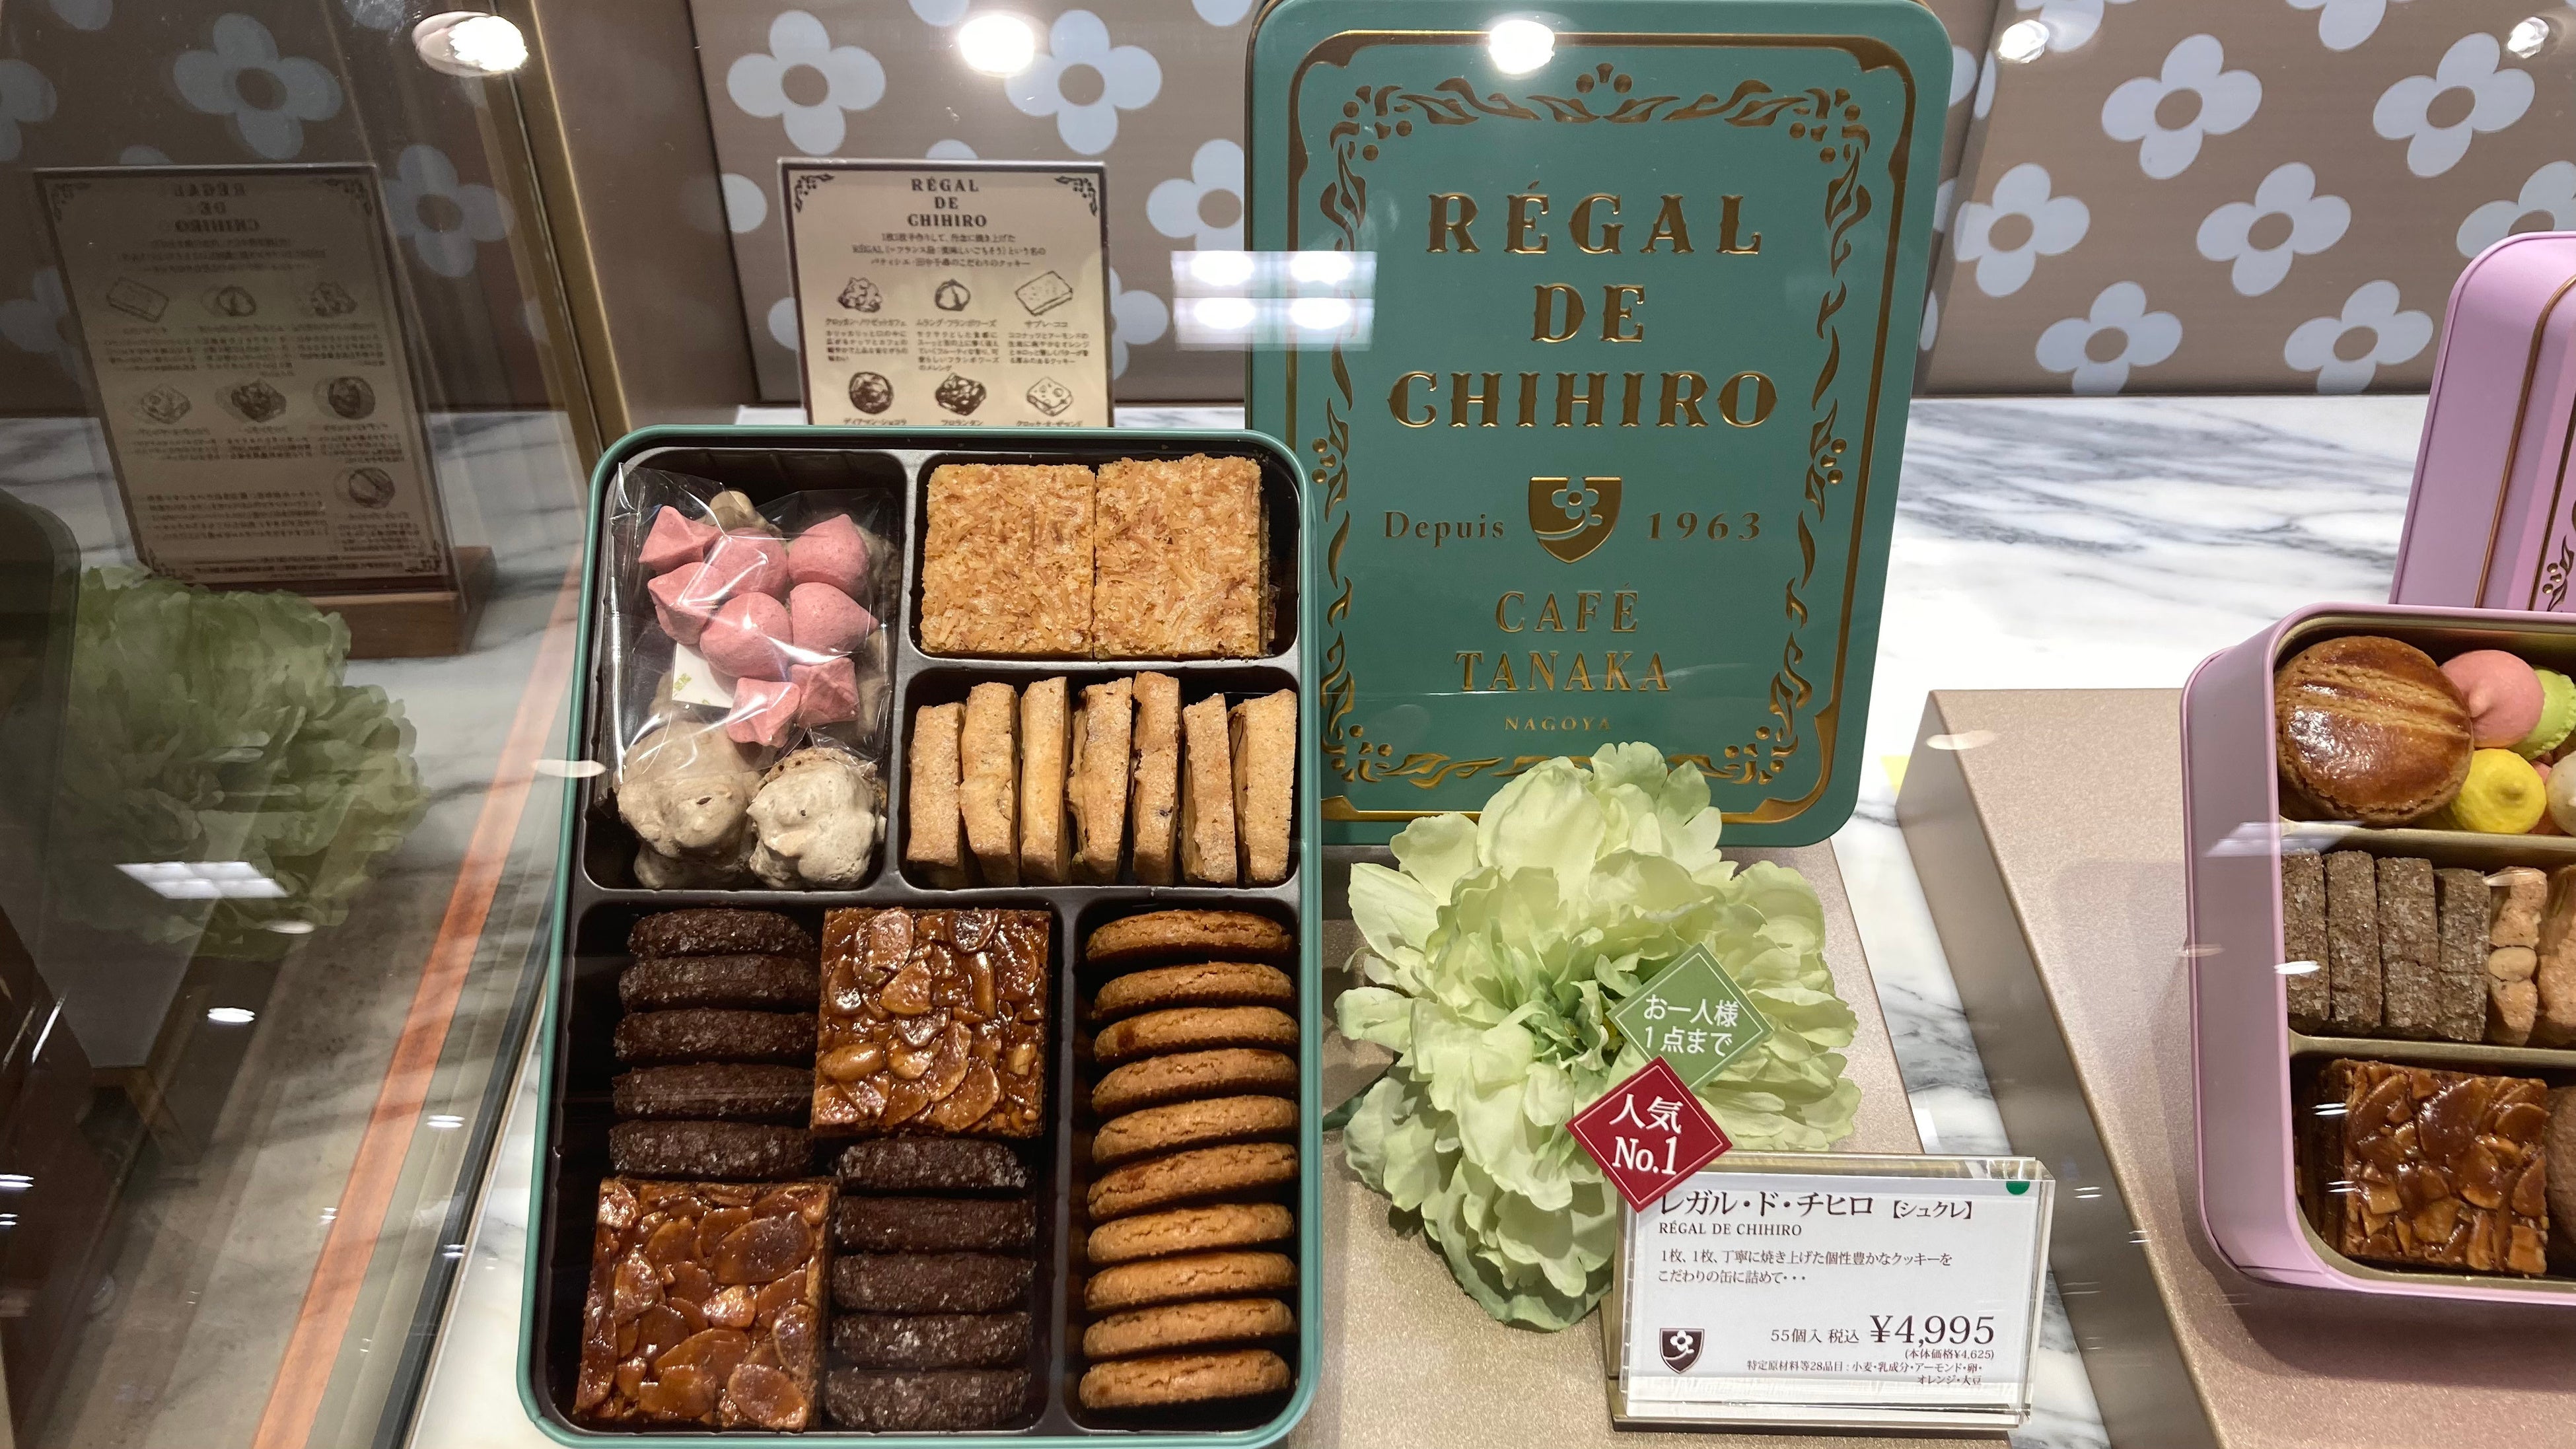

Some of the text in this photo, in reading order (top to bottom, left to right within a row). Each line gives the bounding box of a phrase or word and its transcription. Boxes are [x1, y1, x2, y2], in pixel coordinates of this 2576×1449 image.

[911, 176, 979, 192] RÉGAL
[908, 213, 987, 227] CHIHIRO
[935, 196, 959, 209] DE
[1426, 180, 1762, 255] RÉGAL
[1530, 283, 1645, 343] DE
[1387, 371, 1778, 429] CHIHIRO
[1384, 511, 1760, 548] Depuis 1963
[1495, 583, 1639, 633] CAFÉ
[1455, 651, 1670, 691] TANAKA
[1505, 716, 1612, 731] NAGOYA
[1643, 993, 1740, 1028] お一人様
[1644, 1025, 1733, 1057] 1点まで
[1608, 1092, 1684, 1135] 人気
[1611, 1135, 1678, 1176] No.1
[1661, 1189, 1874, 1217] レガル・ド・チヒロ
[1659, 1220, 1803, 1236] RÉGAL DE CHIHIRO
[1770, 1315, 1995, 1348] 55個入 税込 ¥4,995
